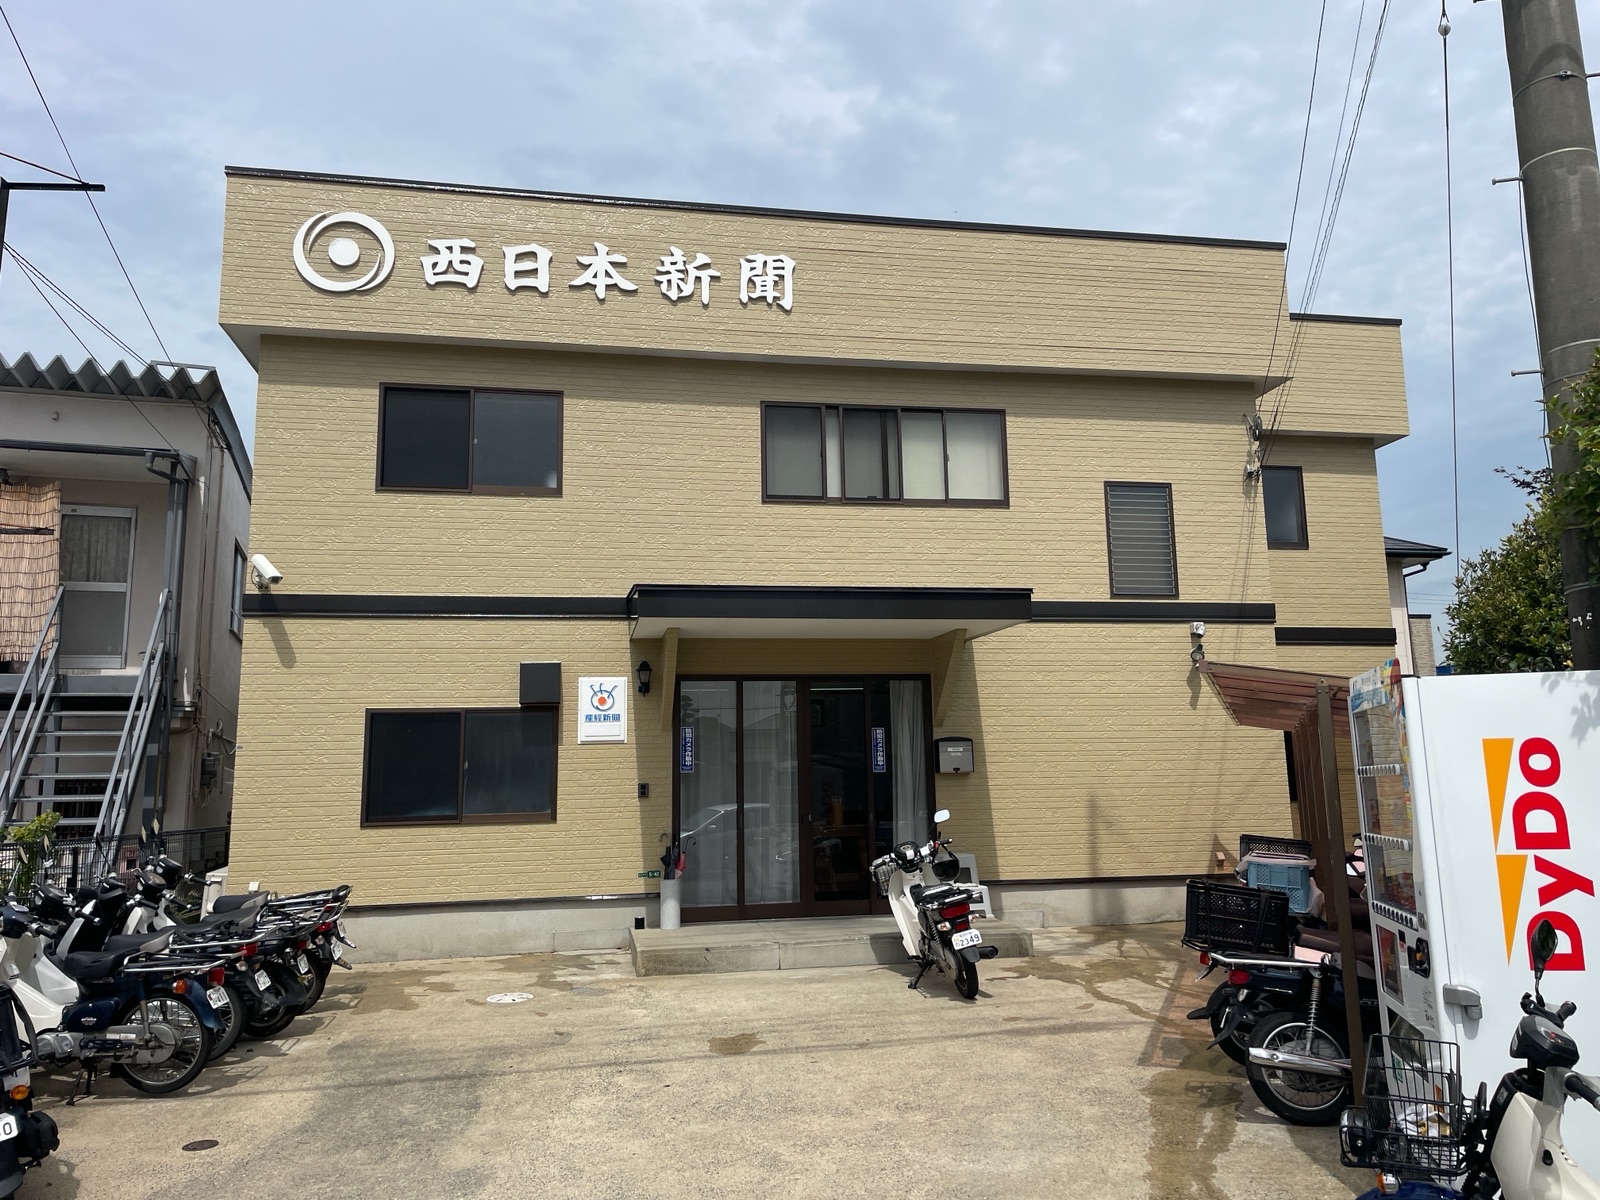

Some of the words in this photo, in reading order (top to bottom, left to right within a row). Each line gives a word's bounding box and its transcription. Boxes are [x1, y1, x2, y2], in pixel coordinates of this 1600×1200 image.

[420, 238, 796, 311] 西日本新聞
[1512, 737, 1596, 971] DyDo
[959, 933, 980, 947] 2349
